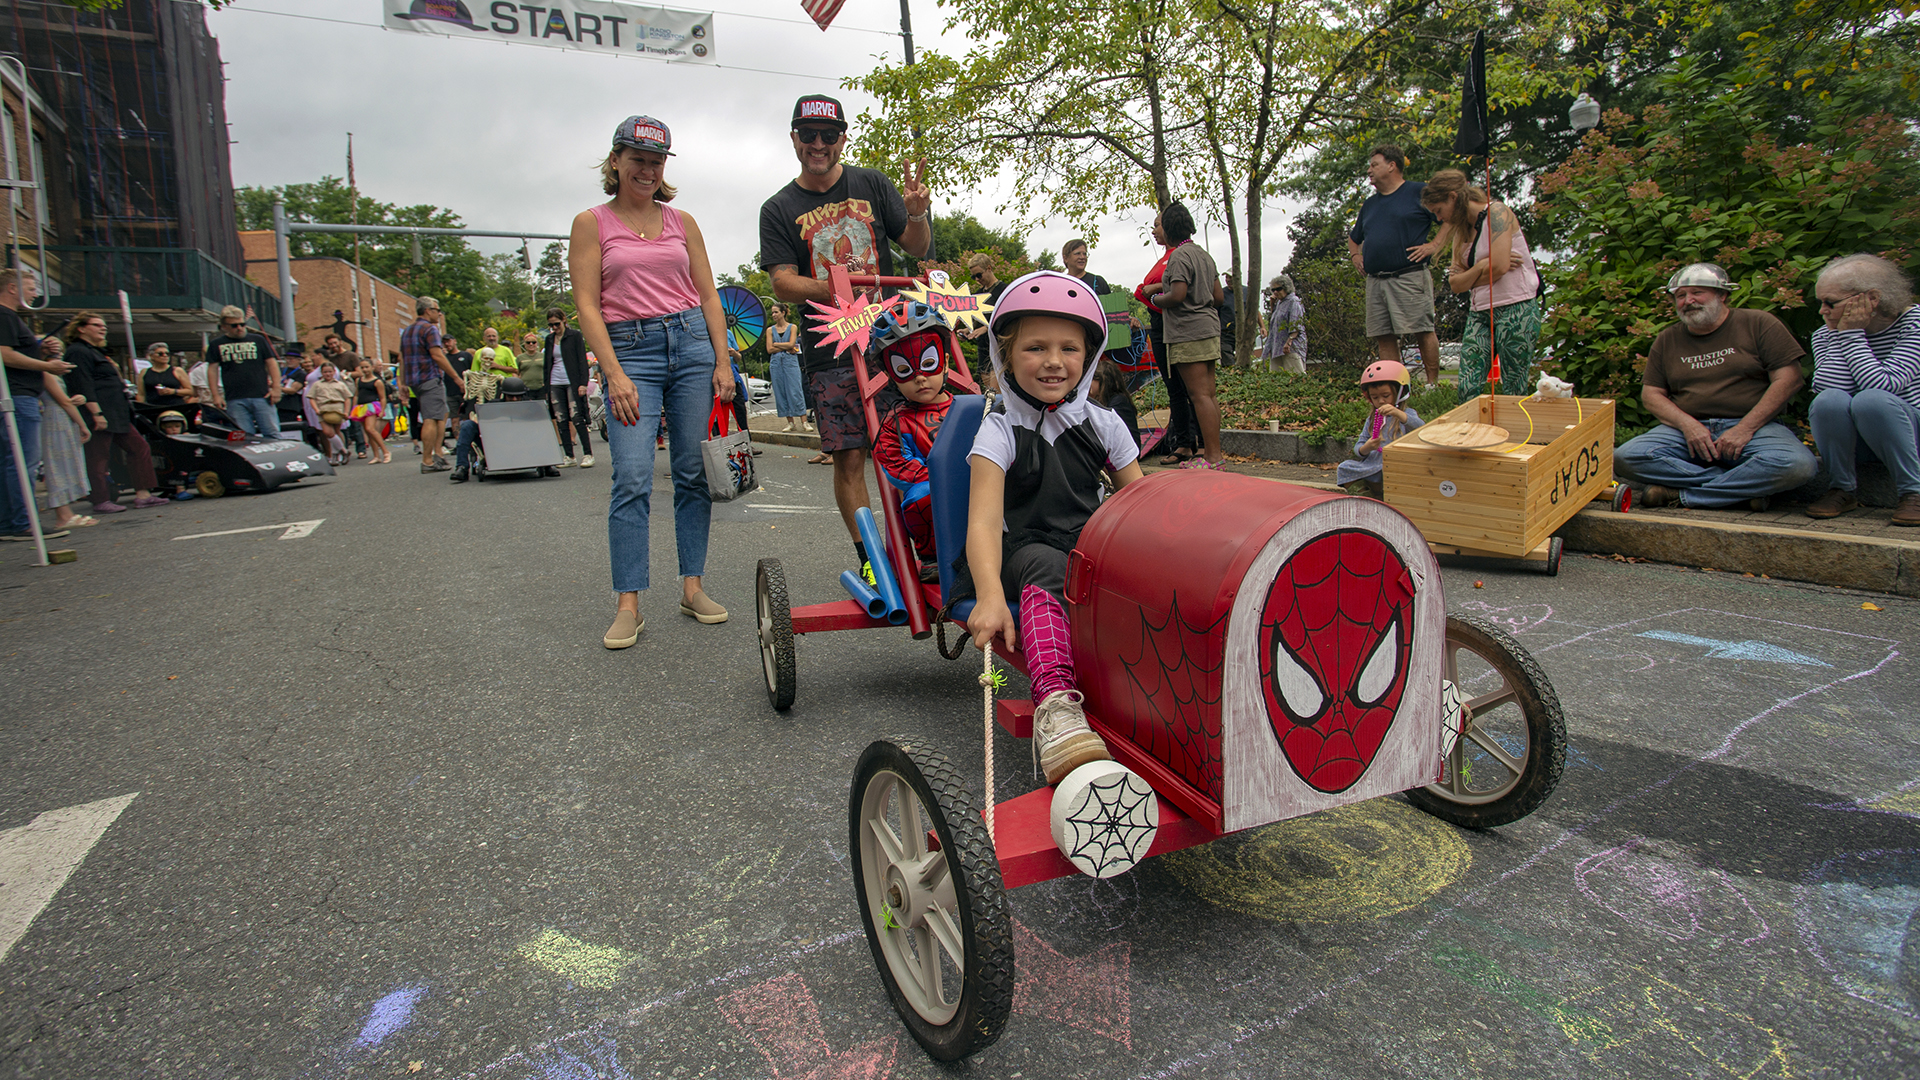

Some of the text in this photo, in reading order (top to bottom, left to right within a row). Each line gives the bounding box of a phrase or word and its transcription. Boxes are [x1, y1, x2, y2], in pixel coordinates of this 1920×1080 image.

[425, 7, 457, 18] DERBY
[490, 1, 628, 47] START
[649, 32, 685, 40] KINGSTON
[801, 101, 837, 118] MARVEL
[635, 125, 665, 142] MARVEL
[795, 197, 873, 240] スパイダーマン
[928, 291, 979, 311] POW!
[218, 341, 258, 356] PSYCHOS
[1680, 347, 1736, 363] VETUSTIOR
[1691, 357, 1725, 369] HUMO
[1550, 440, 1599, 504] SOAP
